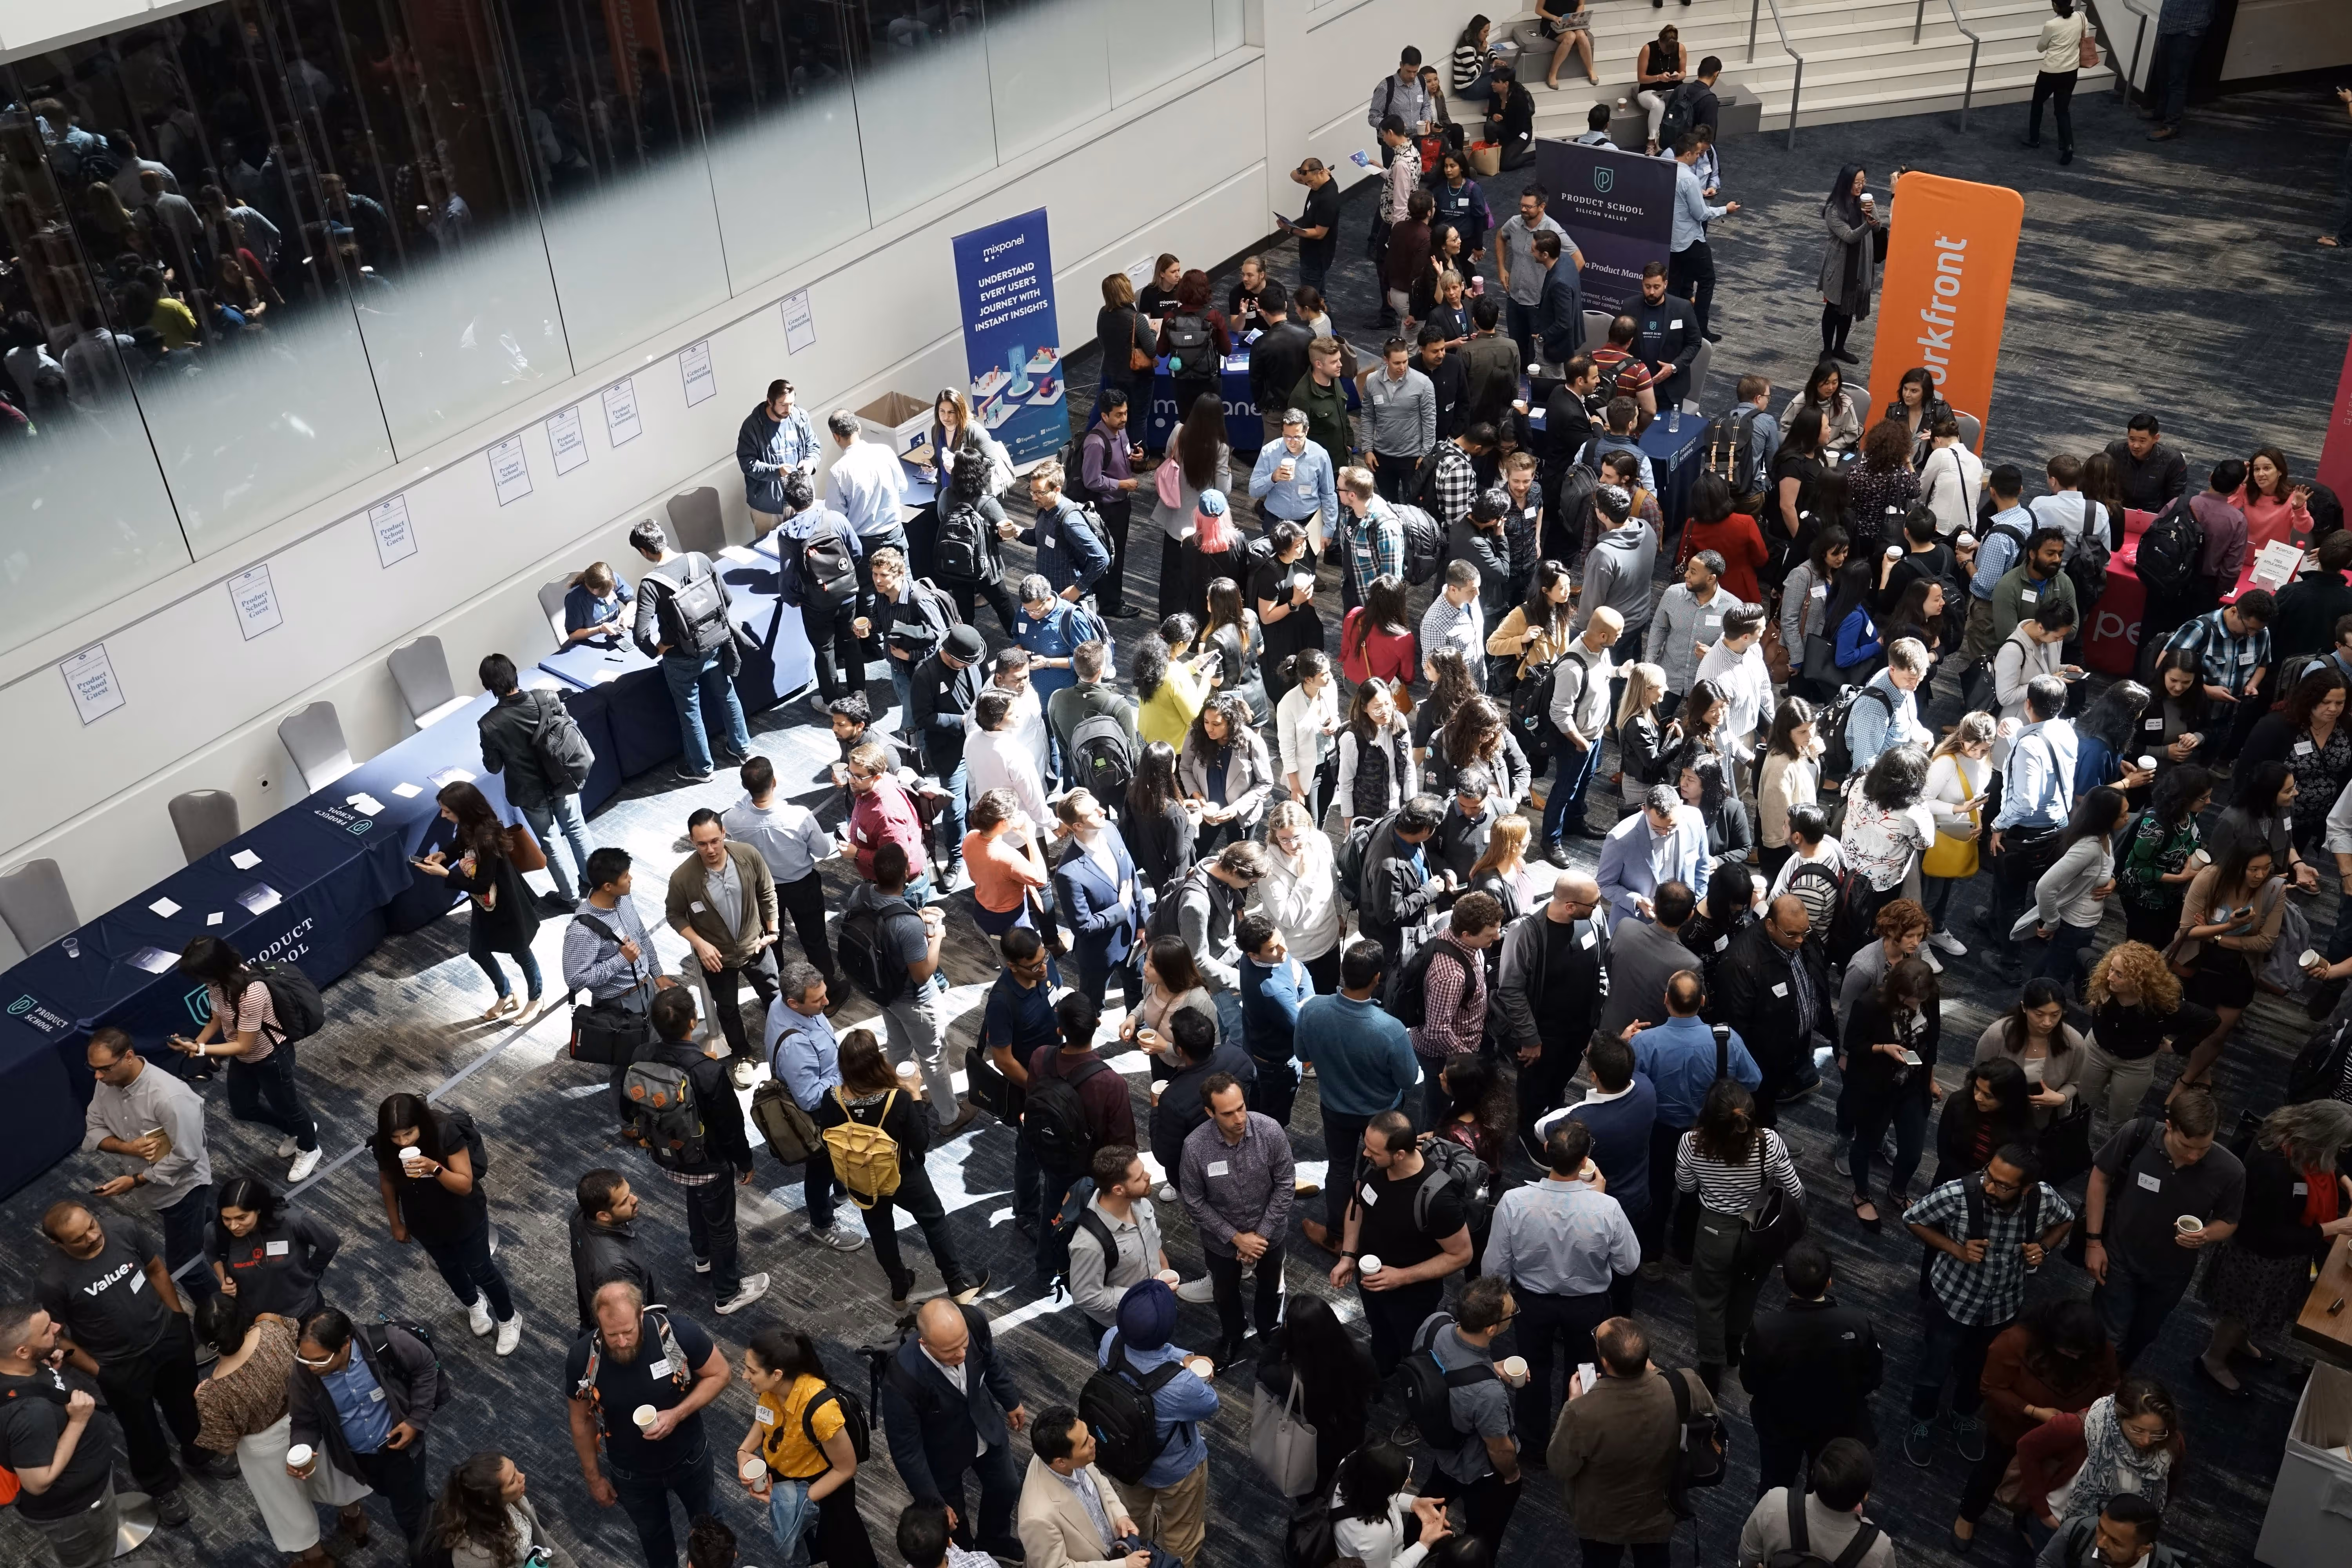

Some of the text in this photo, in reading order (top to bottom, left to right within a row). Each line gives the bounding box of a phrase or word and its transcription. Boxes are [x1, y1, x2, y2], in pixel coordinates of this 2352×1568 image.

[1561, 193, 1644, 215] PRODUCT SCHOOL
[1576, 208, 1601, 216] SILICON
[983, 234, 1024, 256] mixpanel
[978, 262, 1034, 287] UNDERSTAND
[1591, 262, 1620, 275] Product
[1621, 269, 1643, 280] Mana
[980, 276, 1036, 301] EVERY USER'S
[980, 289, 1040, 316] JOURNEY WITH
[1581, 292, 1601, 300] gement,
[1602, 296, 1620, 305] Coding,
[788, 312, 806, 325] General
[975, 300, 1048, 332] INSTANT INSIGHTS
[1917, 236, 1967, 401] orkfront
[788, 318, 810, 332] Admission
[686, 370, 710, 385] Admission
[687, 364, 707, 377] General
[613, 404, 630, 416] Product
[615, 410, 630, 420] School
[611, 413, 636, 428] Community
[557, 431, 575, 443] Product
[560, 437, 575, 448] School
[555, 441, 582, 456] Community
[1680, 437, 1697, 454] PRODUCT
[1679, 447, 1693, 462] SCHOOL
[499, 461, 519, 474] Product
[502, 467, 518, 478] School
[497, 471, 526, 487] Community
[380, 521, 405, 536] Product
[384, 528, 404, 541] School
[387, 535, 405, 546] Guest
[241, 590, 268, 607] Product
[245, 598, 268, 613] School
[249, 606, 269, 618] Guest
[76, 671, 107, 690] Product
[82, 679, 107, 695] School
[86, 687, 109, 701] Guest
[314, 810, 347, 826] PRODUCT
[328, 807, 355, 820] SCHOOL
[24, 1014, 53, 1032] SCHOOL
[34, 1007, 69, 1028] PRODUCT
[1209, 1163, 1227, 1173] SHAHIN
[2140, 1177, 2154, 1186] ERIK
[83, 1264, 129, 1296] Value
